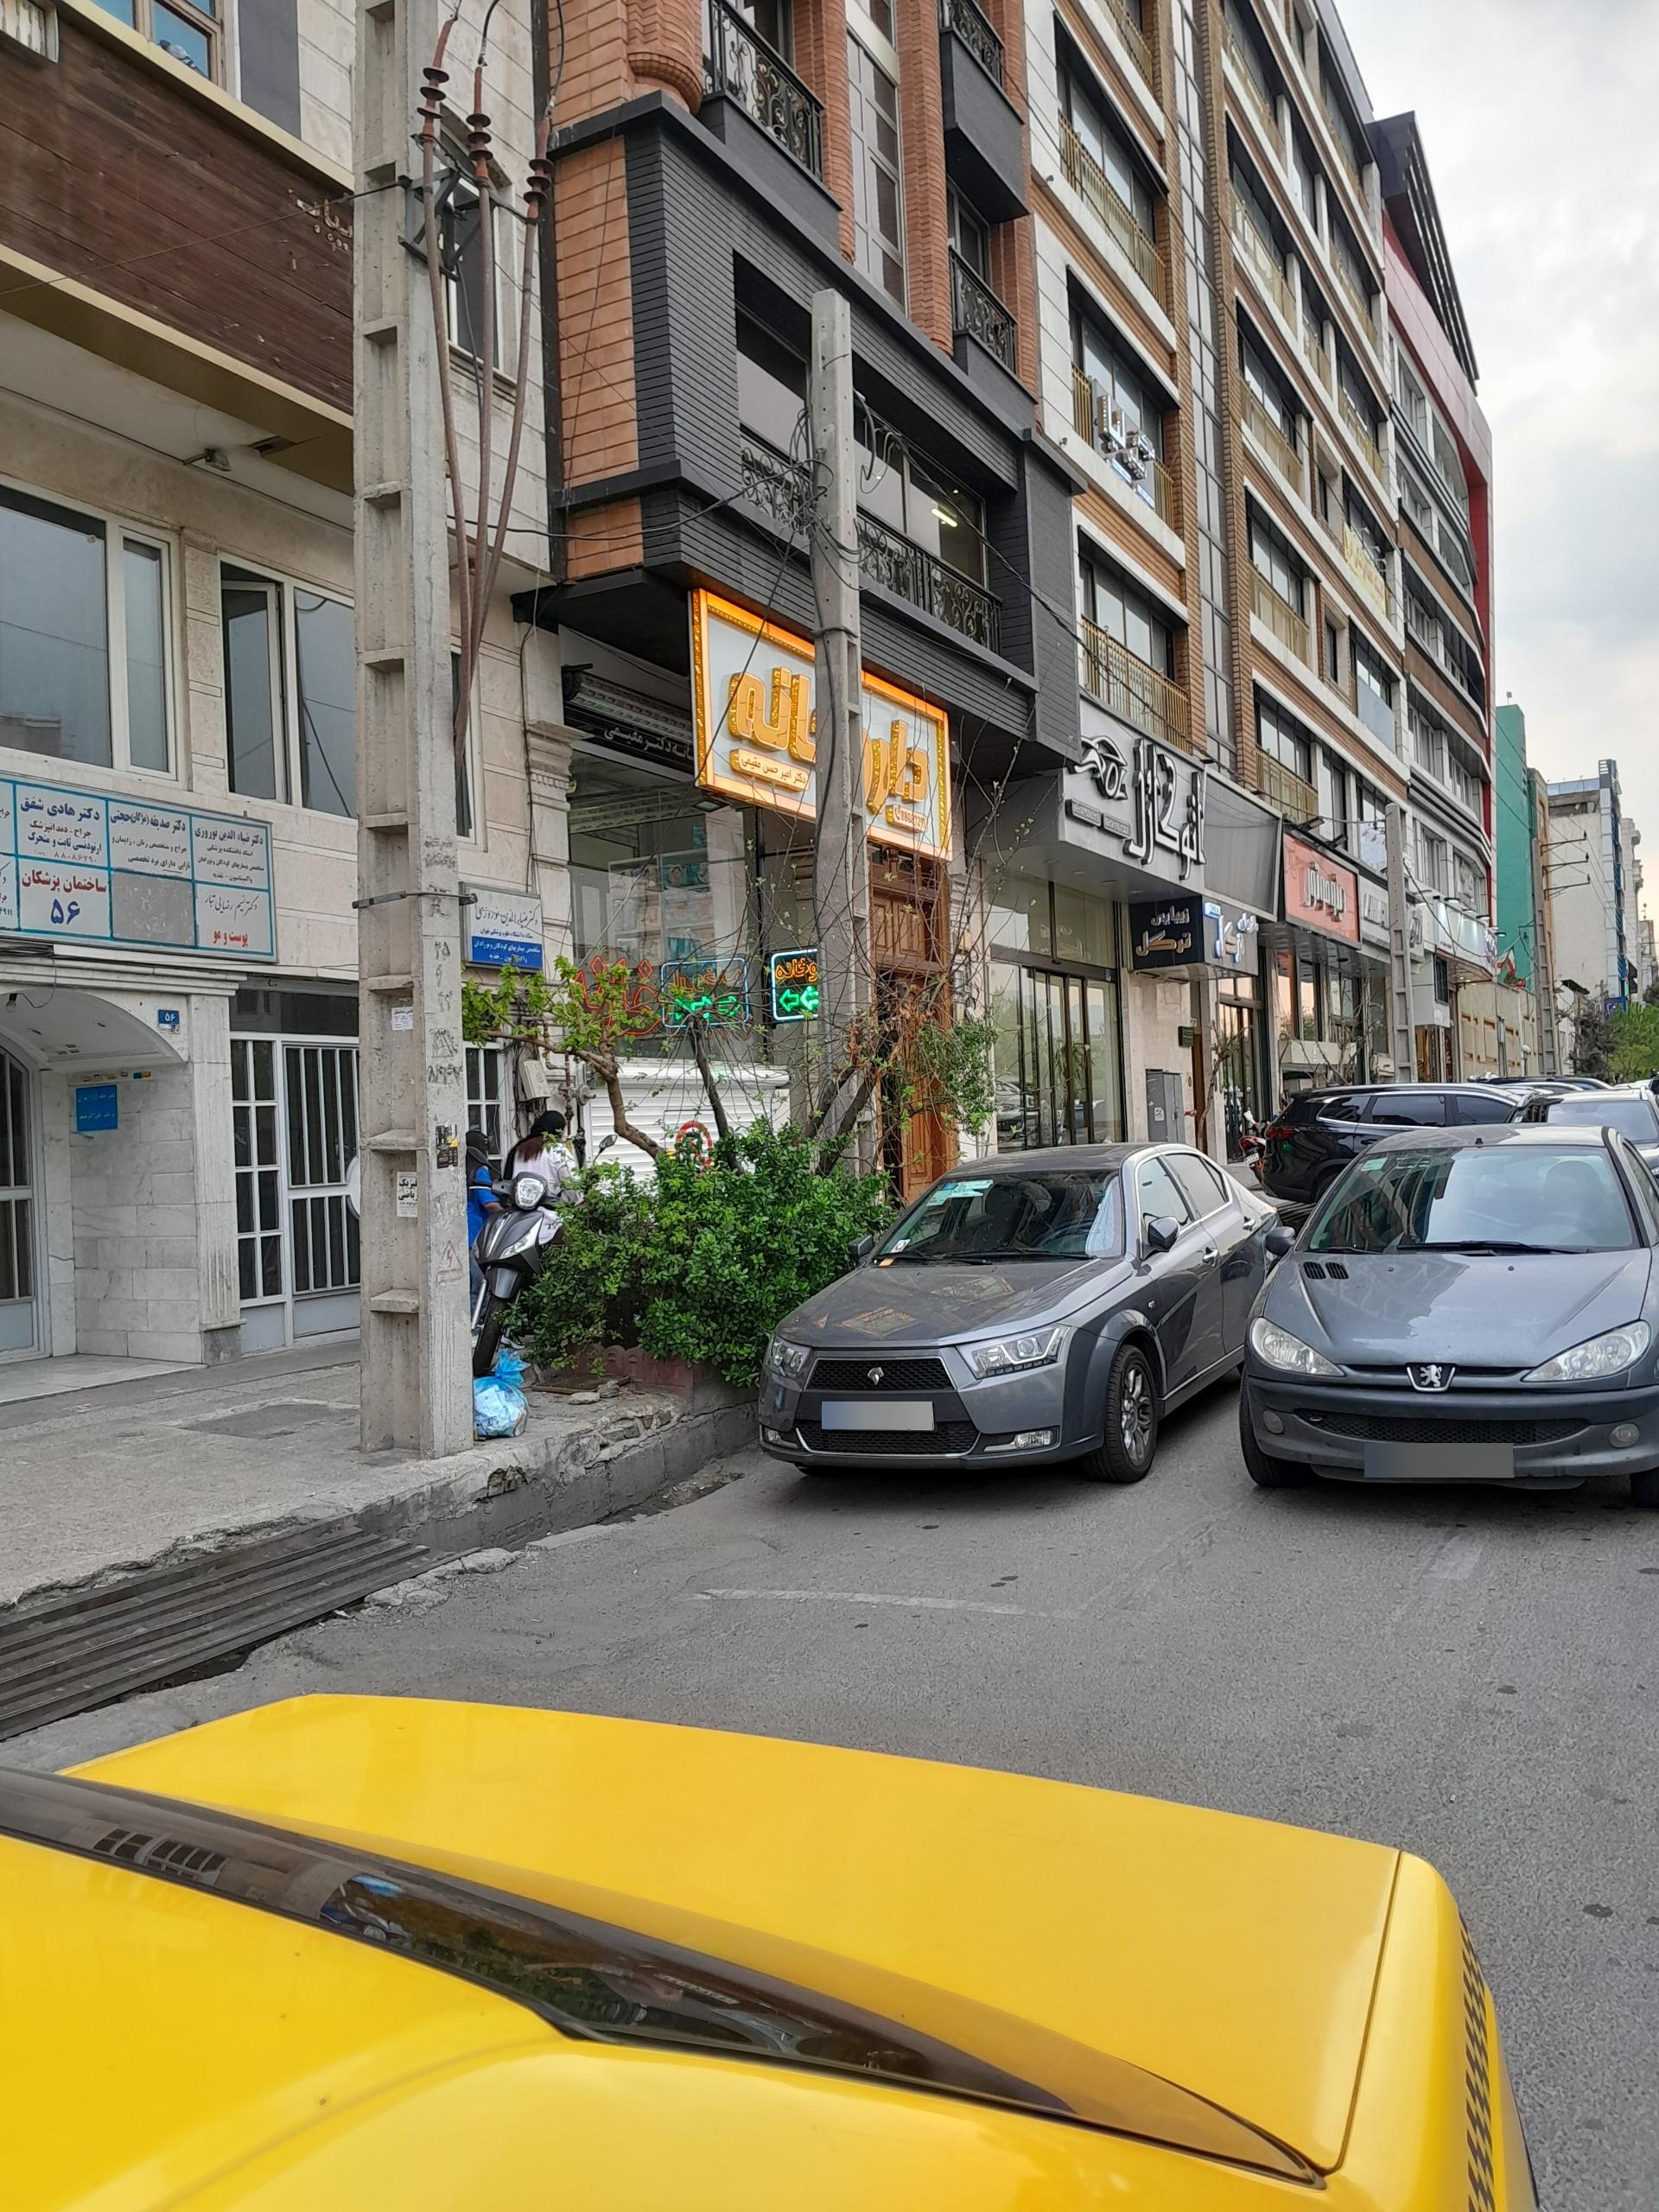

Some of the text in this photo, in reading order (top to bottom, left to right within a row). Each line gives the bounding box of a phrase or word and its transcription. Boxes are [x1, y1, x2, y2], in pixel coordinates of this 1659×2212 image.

[763, 764, 778, 773] حسن
[780, 769, 791, 780] امیر
[793, 772, 806, 784] دکتر
[21, 797, 100, 821] دکتر هادی شفق
[172, 819, 186, 833] دکتر
[73, 828, 92, 838] جراح
[52, 838, 56, 847] و
[251, 835, 264, 847] دکتر
[22, 869, 60, 892] پزشکان
[63, 874, 106, 893] ساختمان
[51, 899, 80, 925] ۵۶
[213, 931, 248, 947] پوست و مو
[164, 1012, 176, 1021] ۵۶
